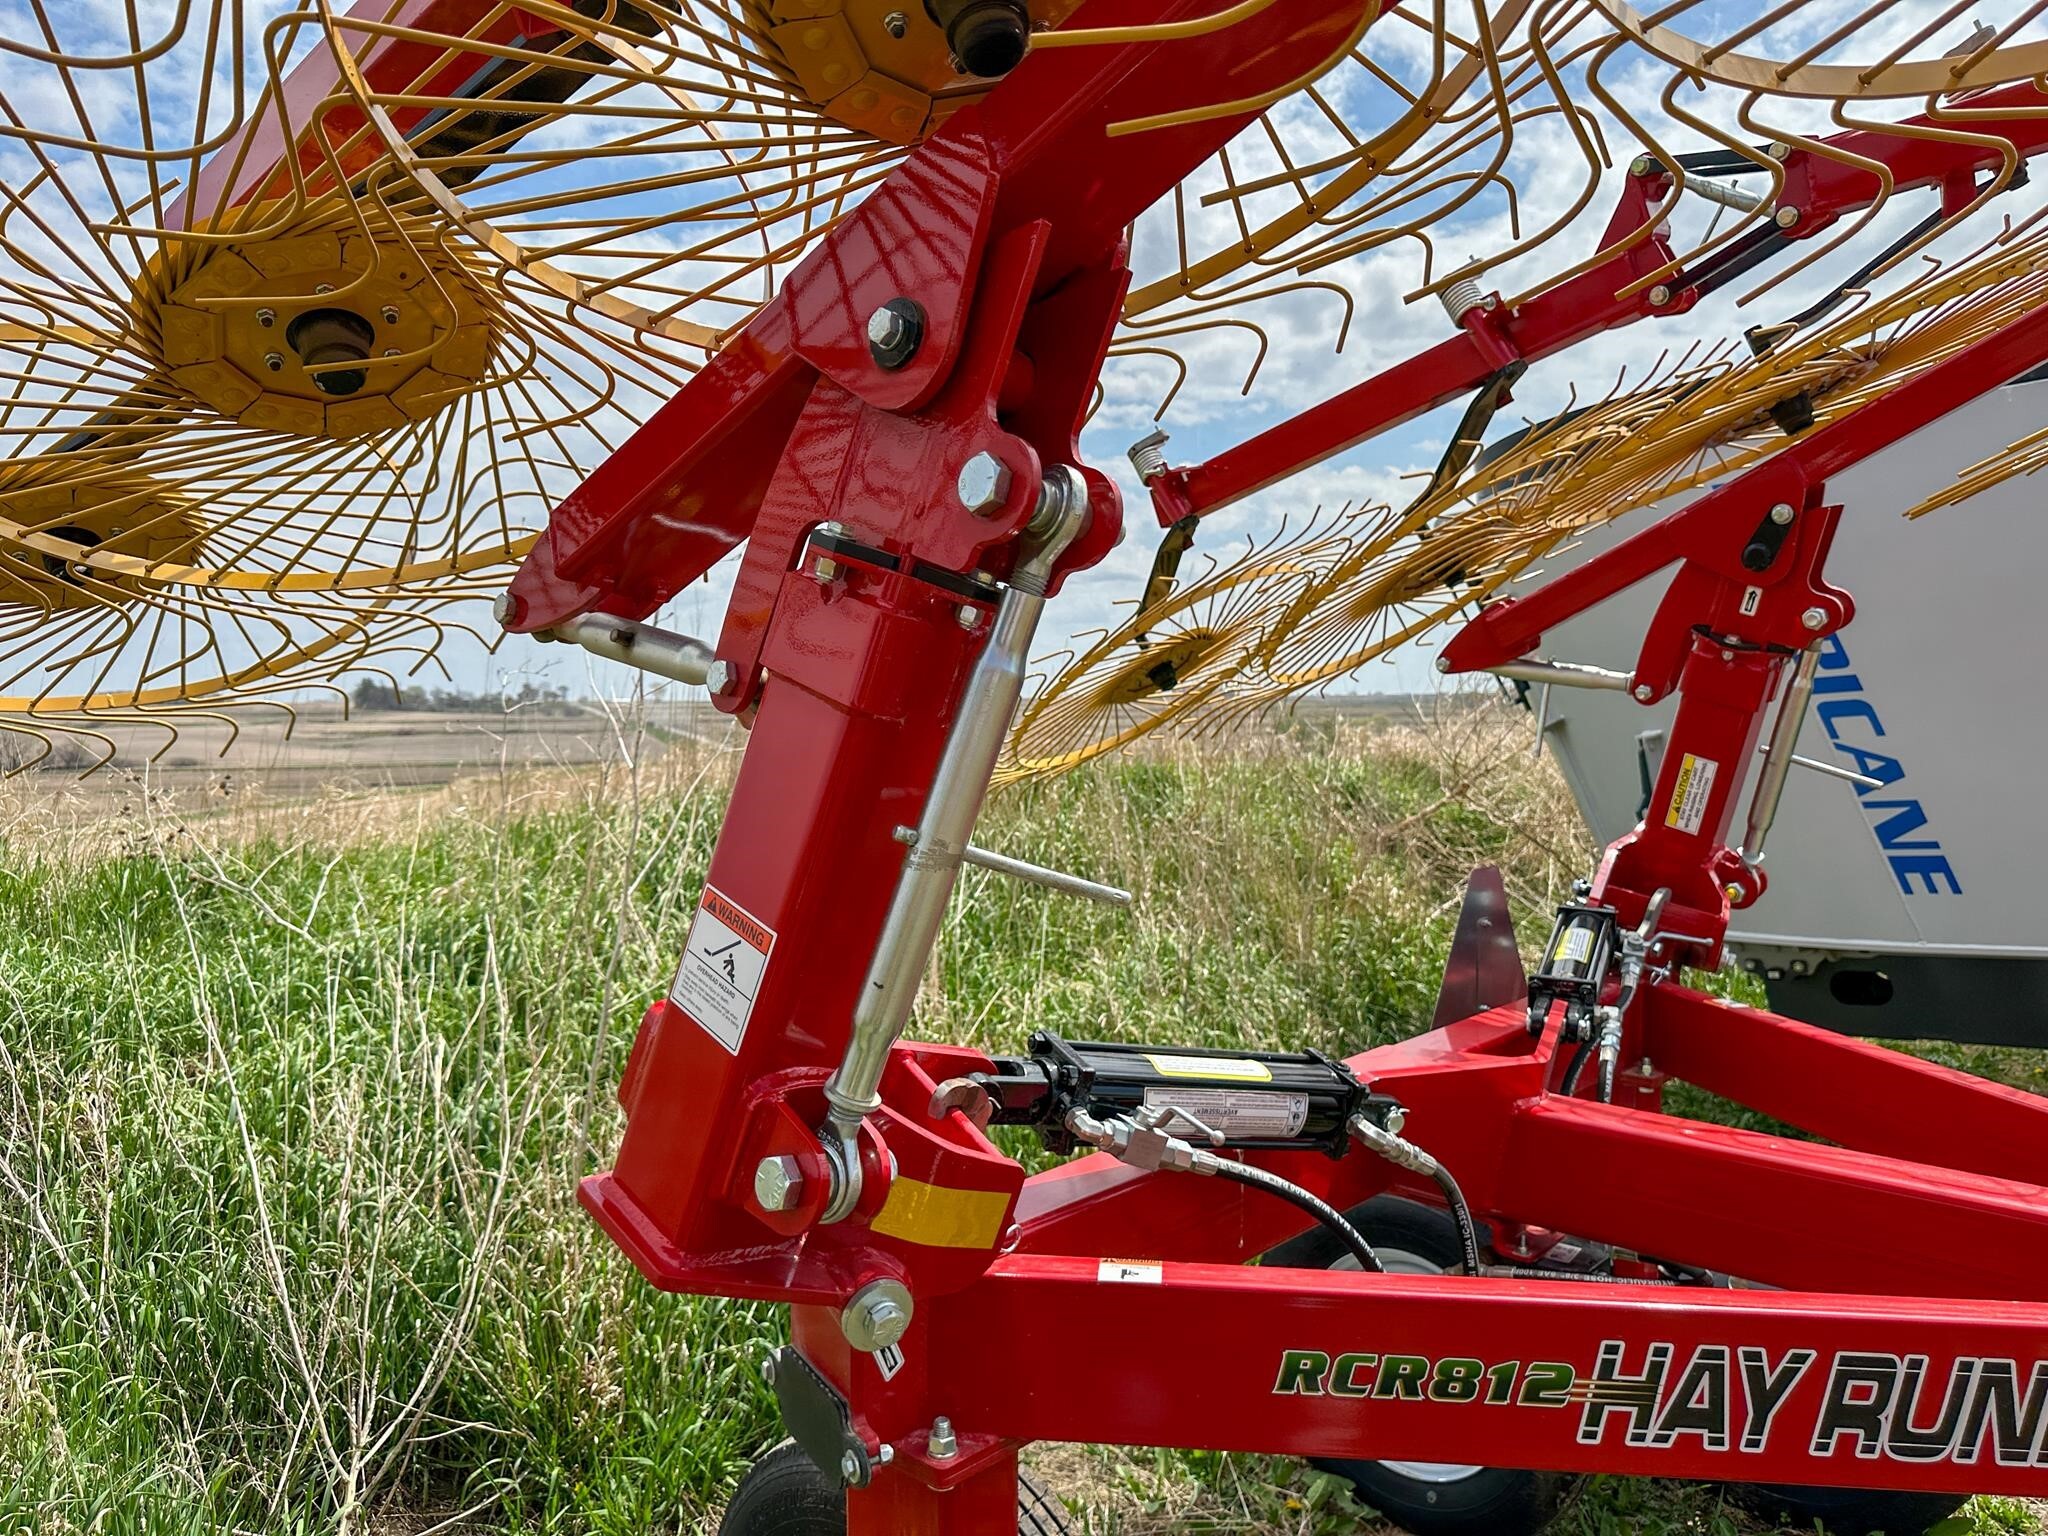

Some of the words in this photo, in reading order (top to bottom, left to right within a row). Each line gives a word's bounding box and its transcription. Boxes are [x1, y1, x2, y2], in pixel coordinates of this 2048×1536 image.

[1674, 767, 1691, 806] CAUTION
[718, 902, 765, 947] WARNING
[1464, 1238, 1476, 1267] MSHA
[1583, 1273, 1613, 1283] HOSE
[1272, 1349, 1576, 1407] RCR812
[1577, 1339, 1817, 1453] HAY
[1808, 1350, 2048, 1468] RUN
